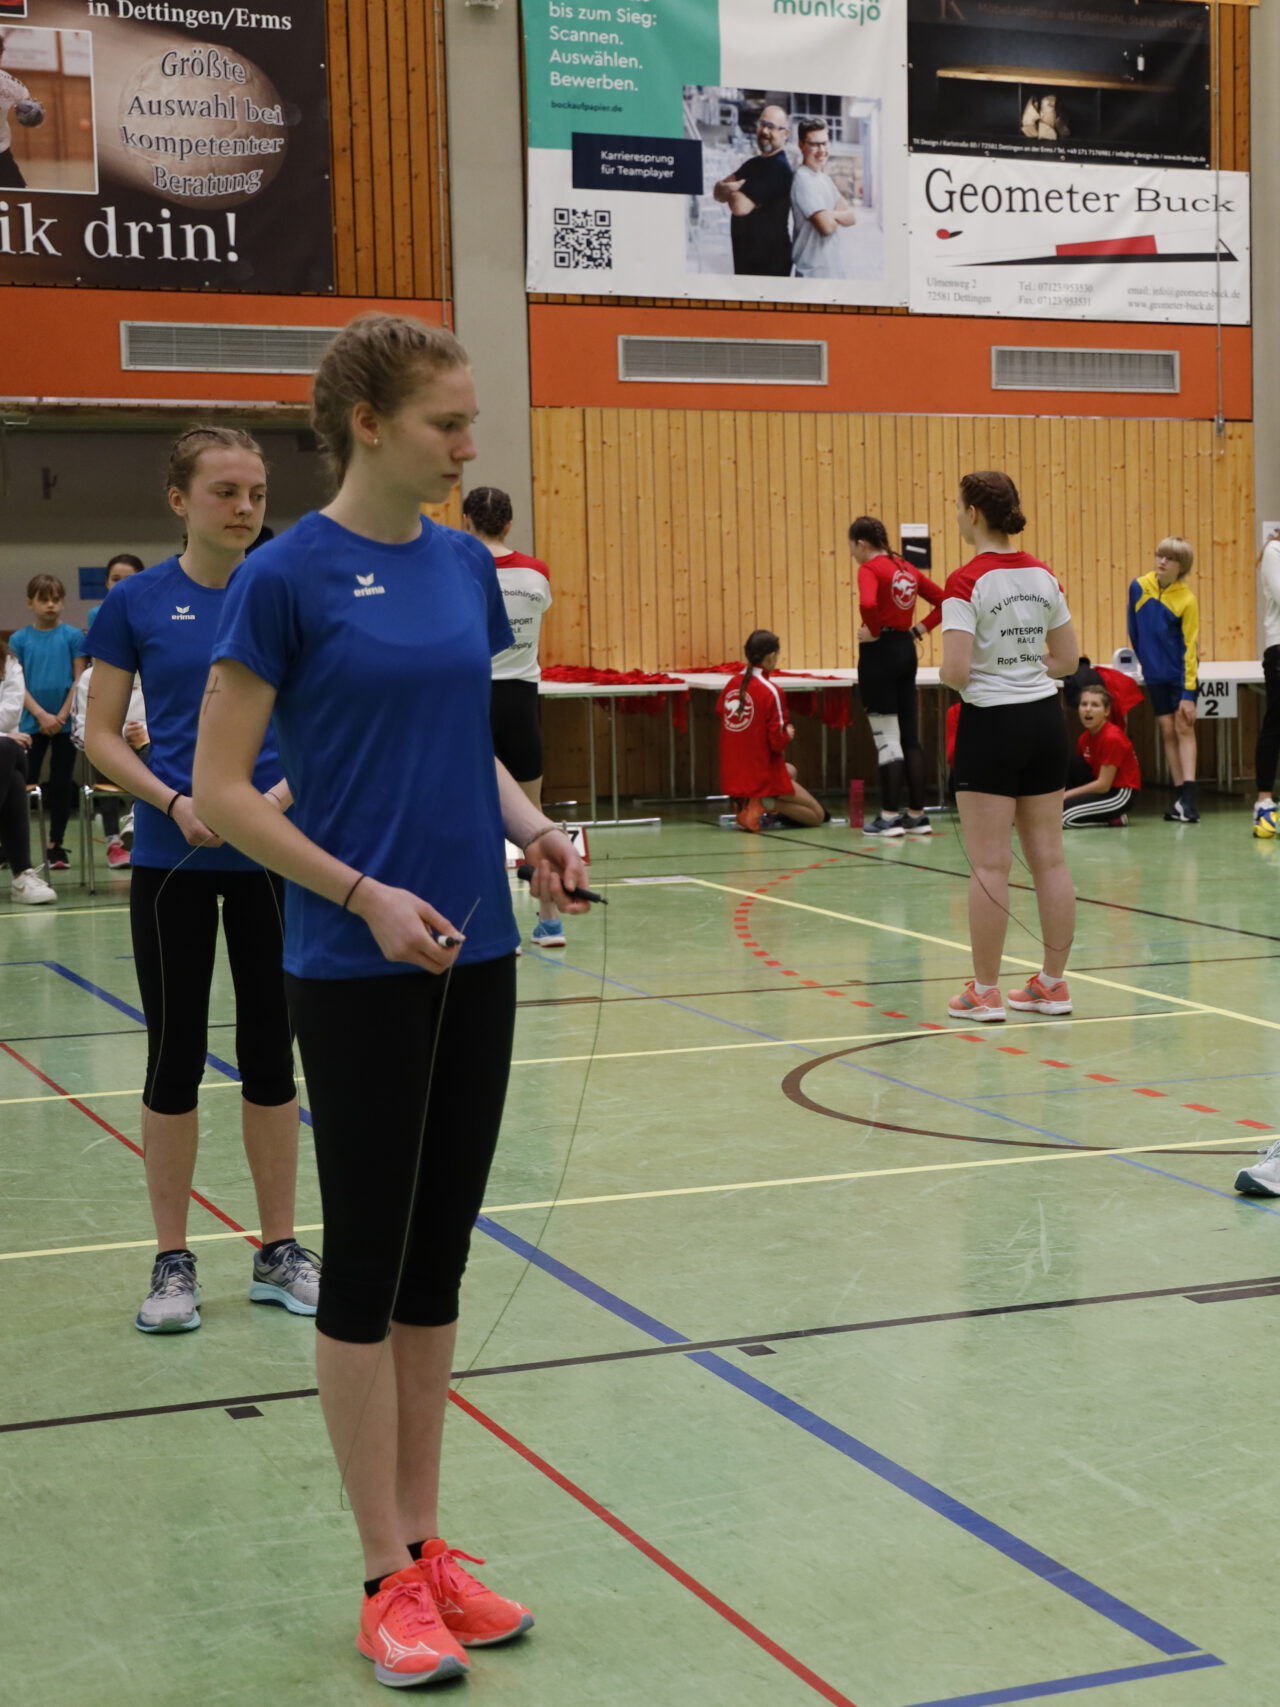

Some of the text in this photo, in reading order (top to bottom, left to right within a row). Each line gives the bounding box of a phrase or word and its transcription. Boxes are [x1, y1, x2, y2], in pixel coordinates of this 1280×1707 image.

[88, 0, 292, 30] in Dettingen/Erms
[549, 1, 657, 28] bis zum Sieg:
[549, 25, 624, 45] Scannen.
[161, 49, 245, 83] Größte
[549, 49, 643, 69] Auswählen.
[550, 71, 639, 91] Bewerben.
[128, 94, 284, 125] Auswahl bei
[122, 125, 283, 161] kompetenter
[600, 150, 675, 166] Karrieresprung
[154, 164, 263, 196] Beratung
[601, 164, 675, 179] für Teamplayer
[925, 168, 1236, 214] Geometer Buck
[84, 206, 238, 262] drin!
[953, 293, 992, 305] Dettingen
[353, 586, 385, 597] erima
[990, 602, 1002, 615] TV
[1198, 681, 1229, 697] KARI
[1205, 699, 1219, 716] 2
